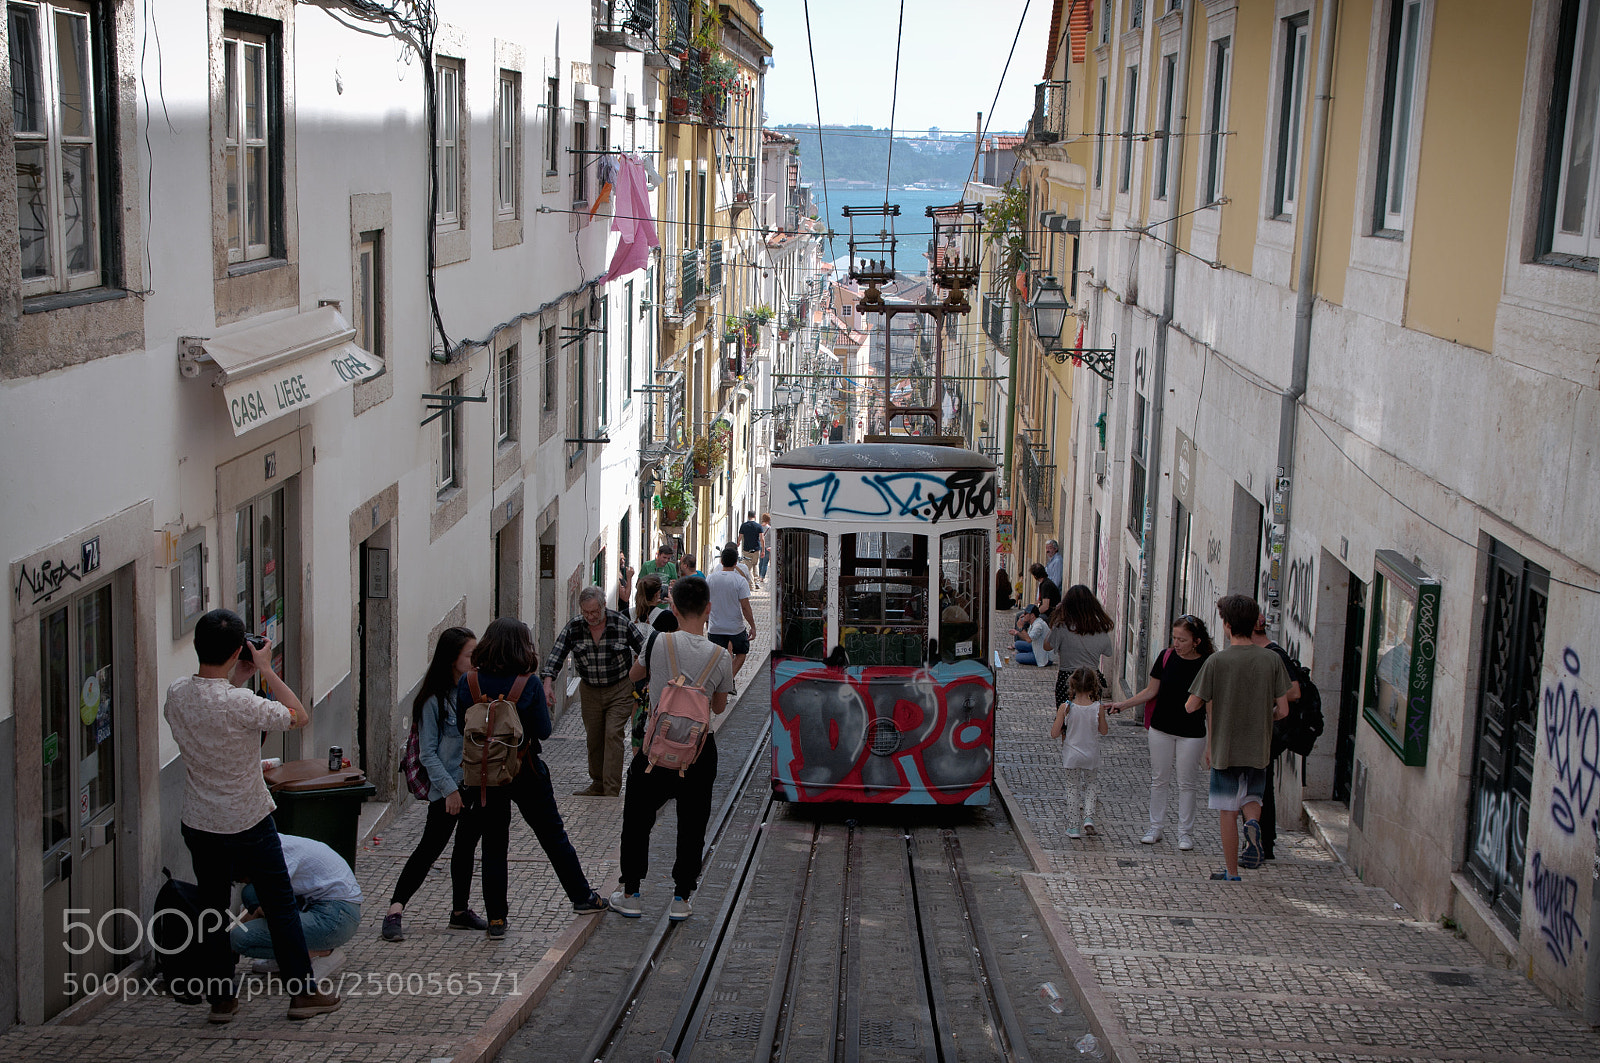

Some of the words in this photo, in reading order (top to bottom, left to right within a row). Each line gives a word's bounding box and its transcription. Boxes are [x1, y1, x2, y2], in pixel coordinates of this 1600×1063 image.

[231, 390, 268, 428] CASA
[274, 374, 311, 410] LIEGE
[331, 353, 372, 382] TOFA
